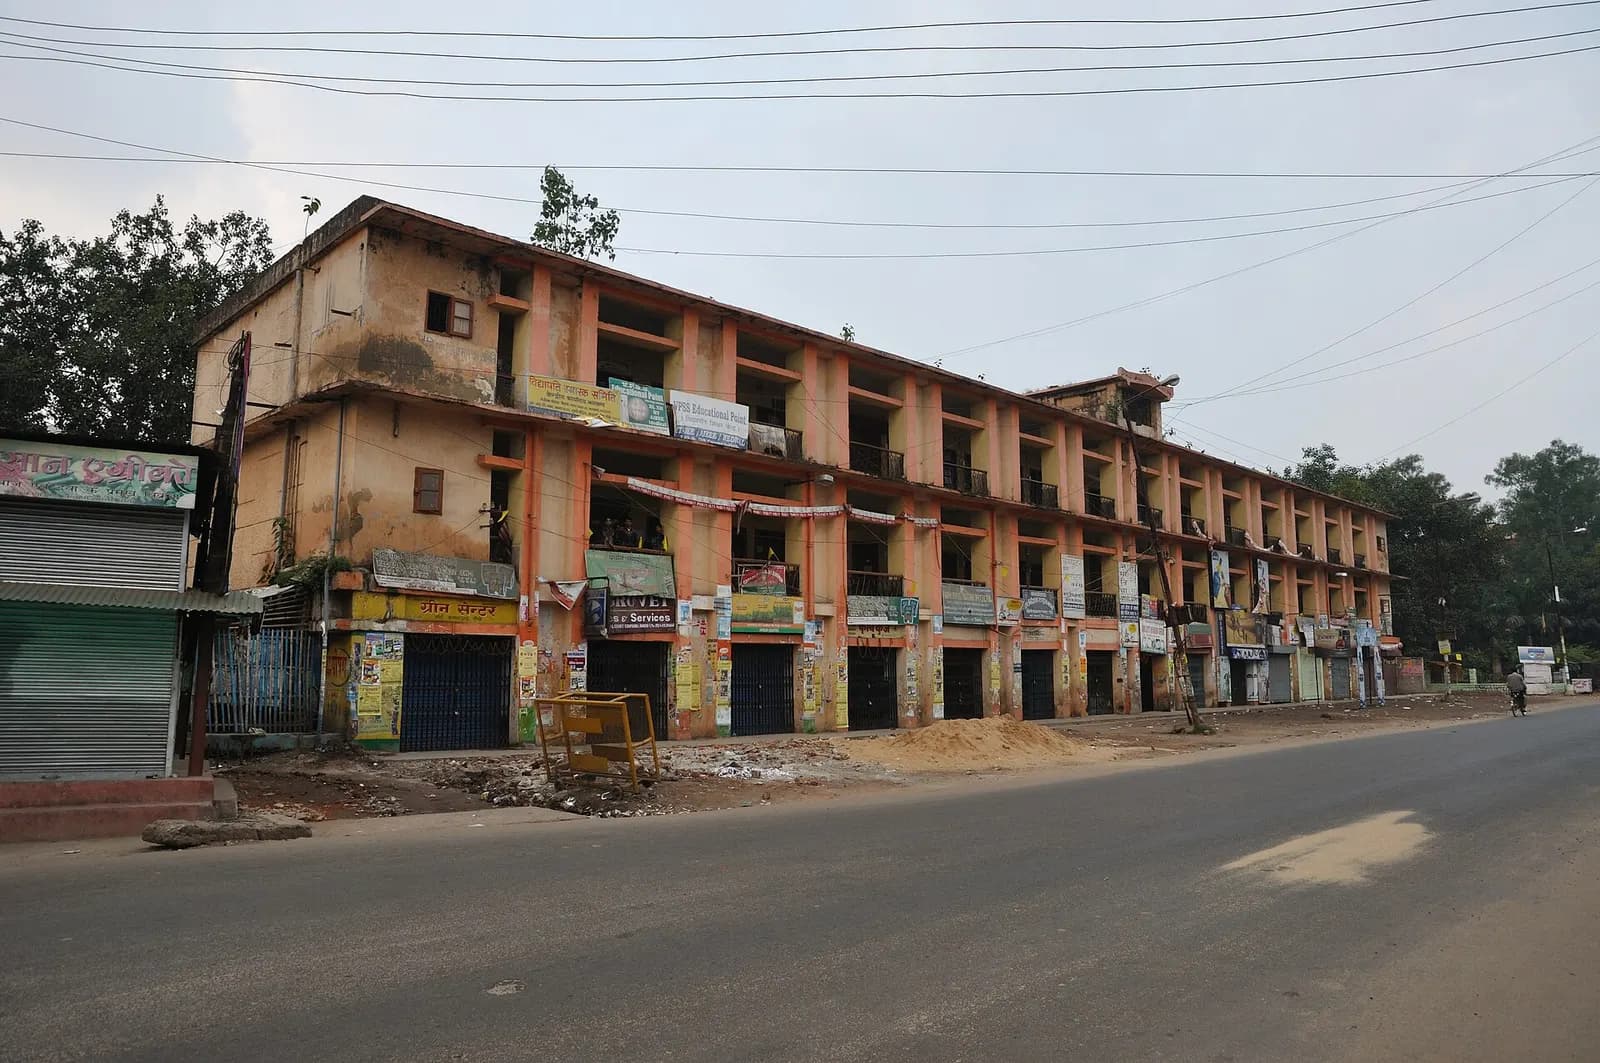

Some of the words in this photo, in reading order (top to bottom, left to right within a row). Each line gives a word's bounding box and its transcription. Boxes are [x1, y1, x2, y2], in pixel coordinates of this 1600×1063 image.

[692, 403, 729, 420] Educational
[730, 411, 747, 425] Point
[420, 600, 450, 614] ग्रीन
[630, 612, 671, 623] Services
